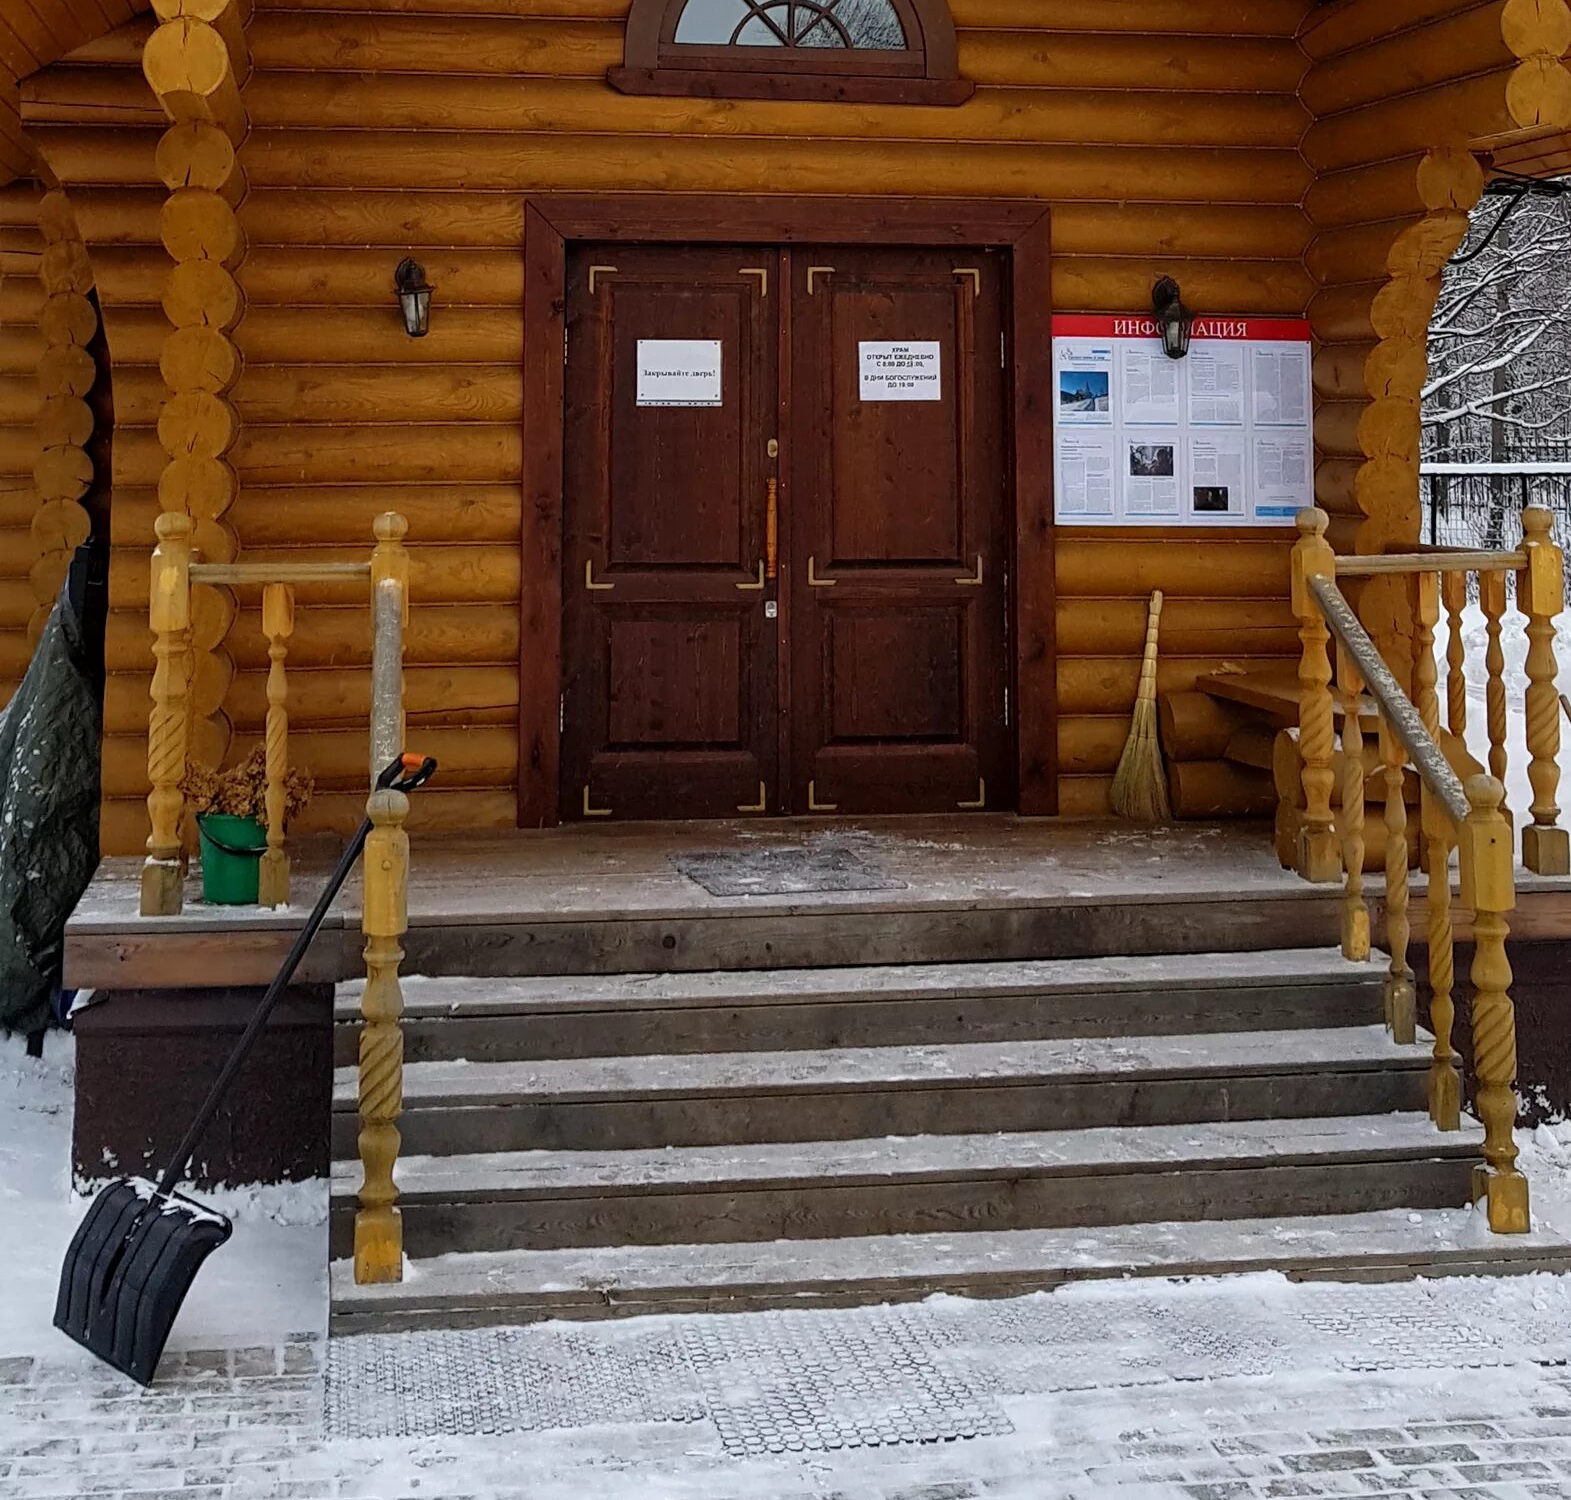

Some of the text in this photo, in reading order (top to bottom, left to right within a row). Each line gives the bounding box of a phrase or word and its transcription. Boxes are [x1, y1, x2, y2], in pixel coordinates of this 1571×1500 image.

[1114, 319, 1247, 338] ИНФАЦИЯ
[643, 369, 716, 378] Закрывайте дверь!
